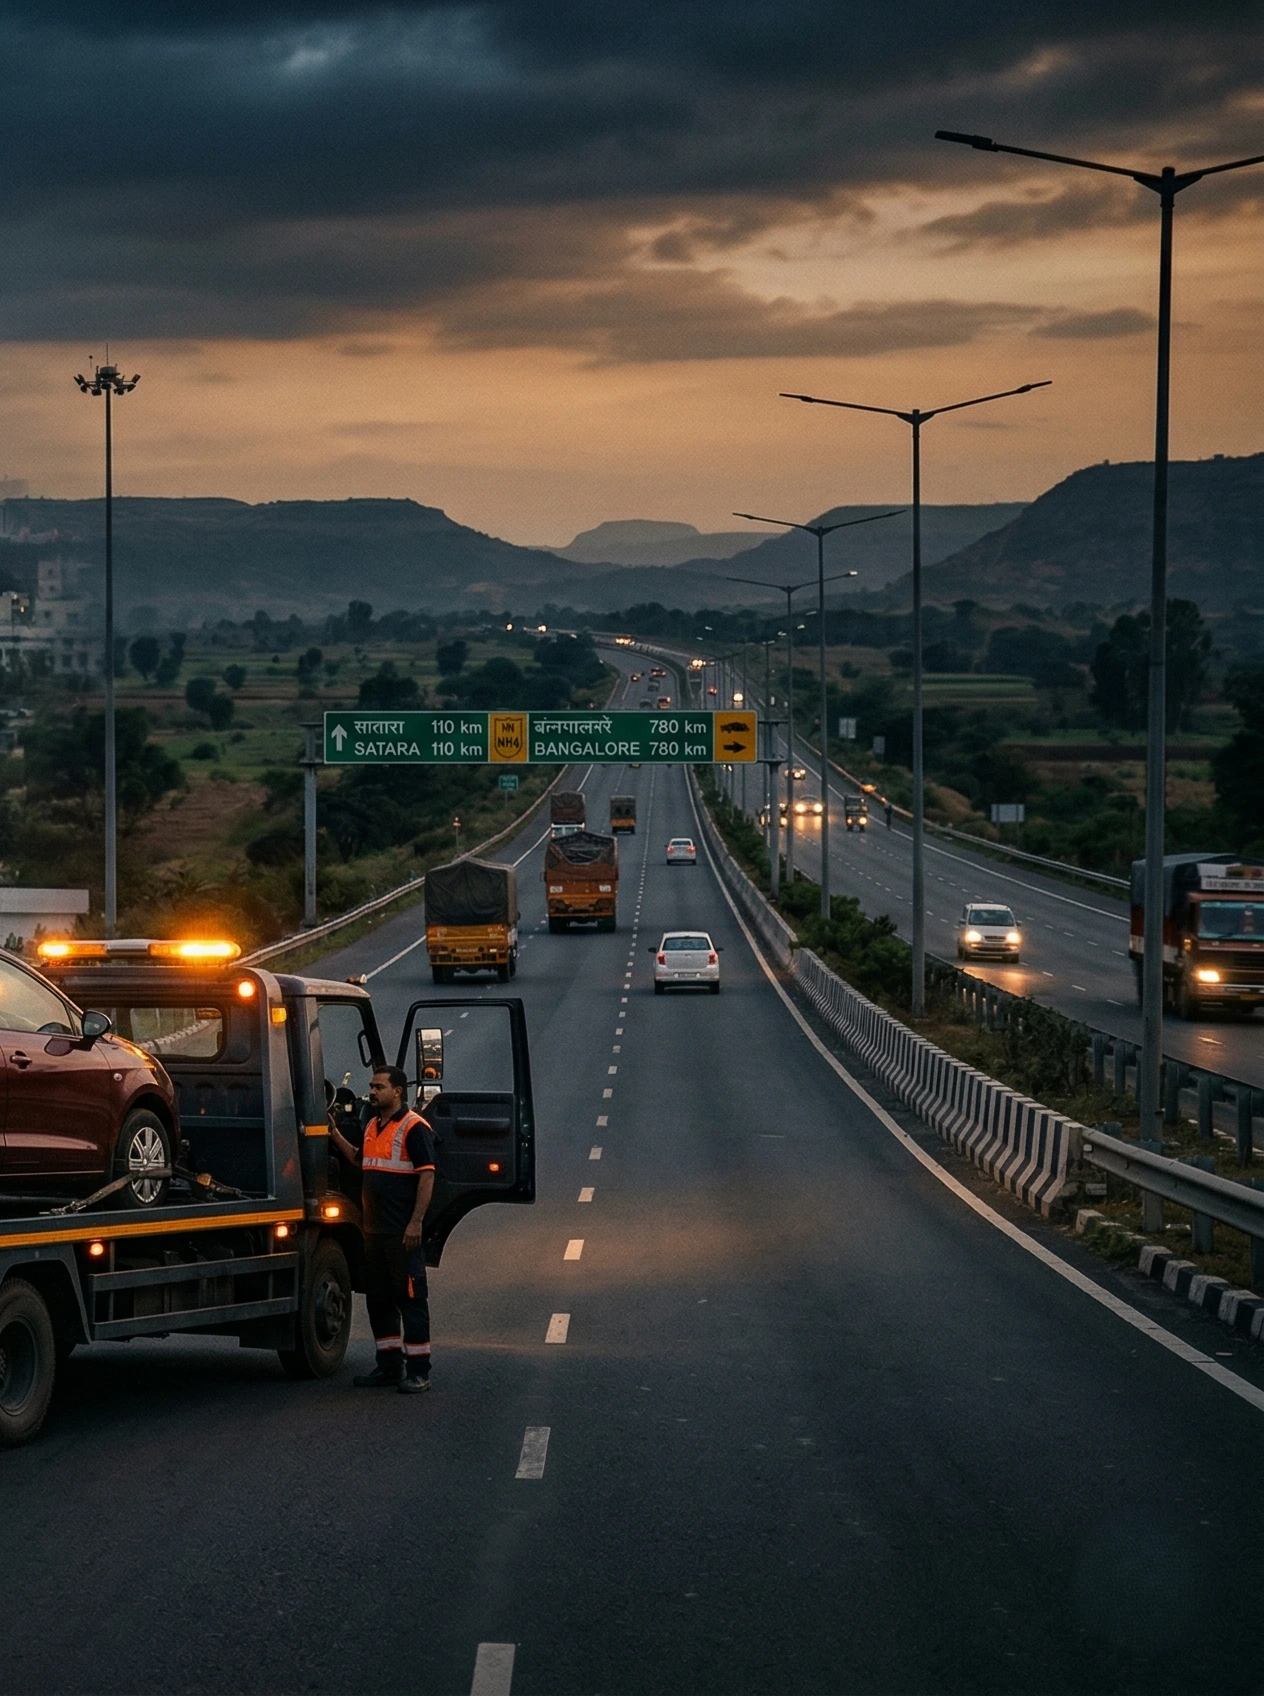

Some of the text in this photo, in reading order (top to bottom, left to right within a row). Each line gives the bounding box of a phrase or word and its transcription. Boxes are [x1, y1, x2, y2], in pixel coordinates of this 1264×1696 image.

[353, 720, 483, 735] सातारा 110 km
[649, 720, 679, 734] 780
[685, 720, 707, 734] km
[354, 742, 483, 756] SATARA 110 km
[497, 737, 520, 748] NH4
[534, 742, 707, 756] BANGALORE 780 km
